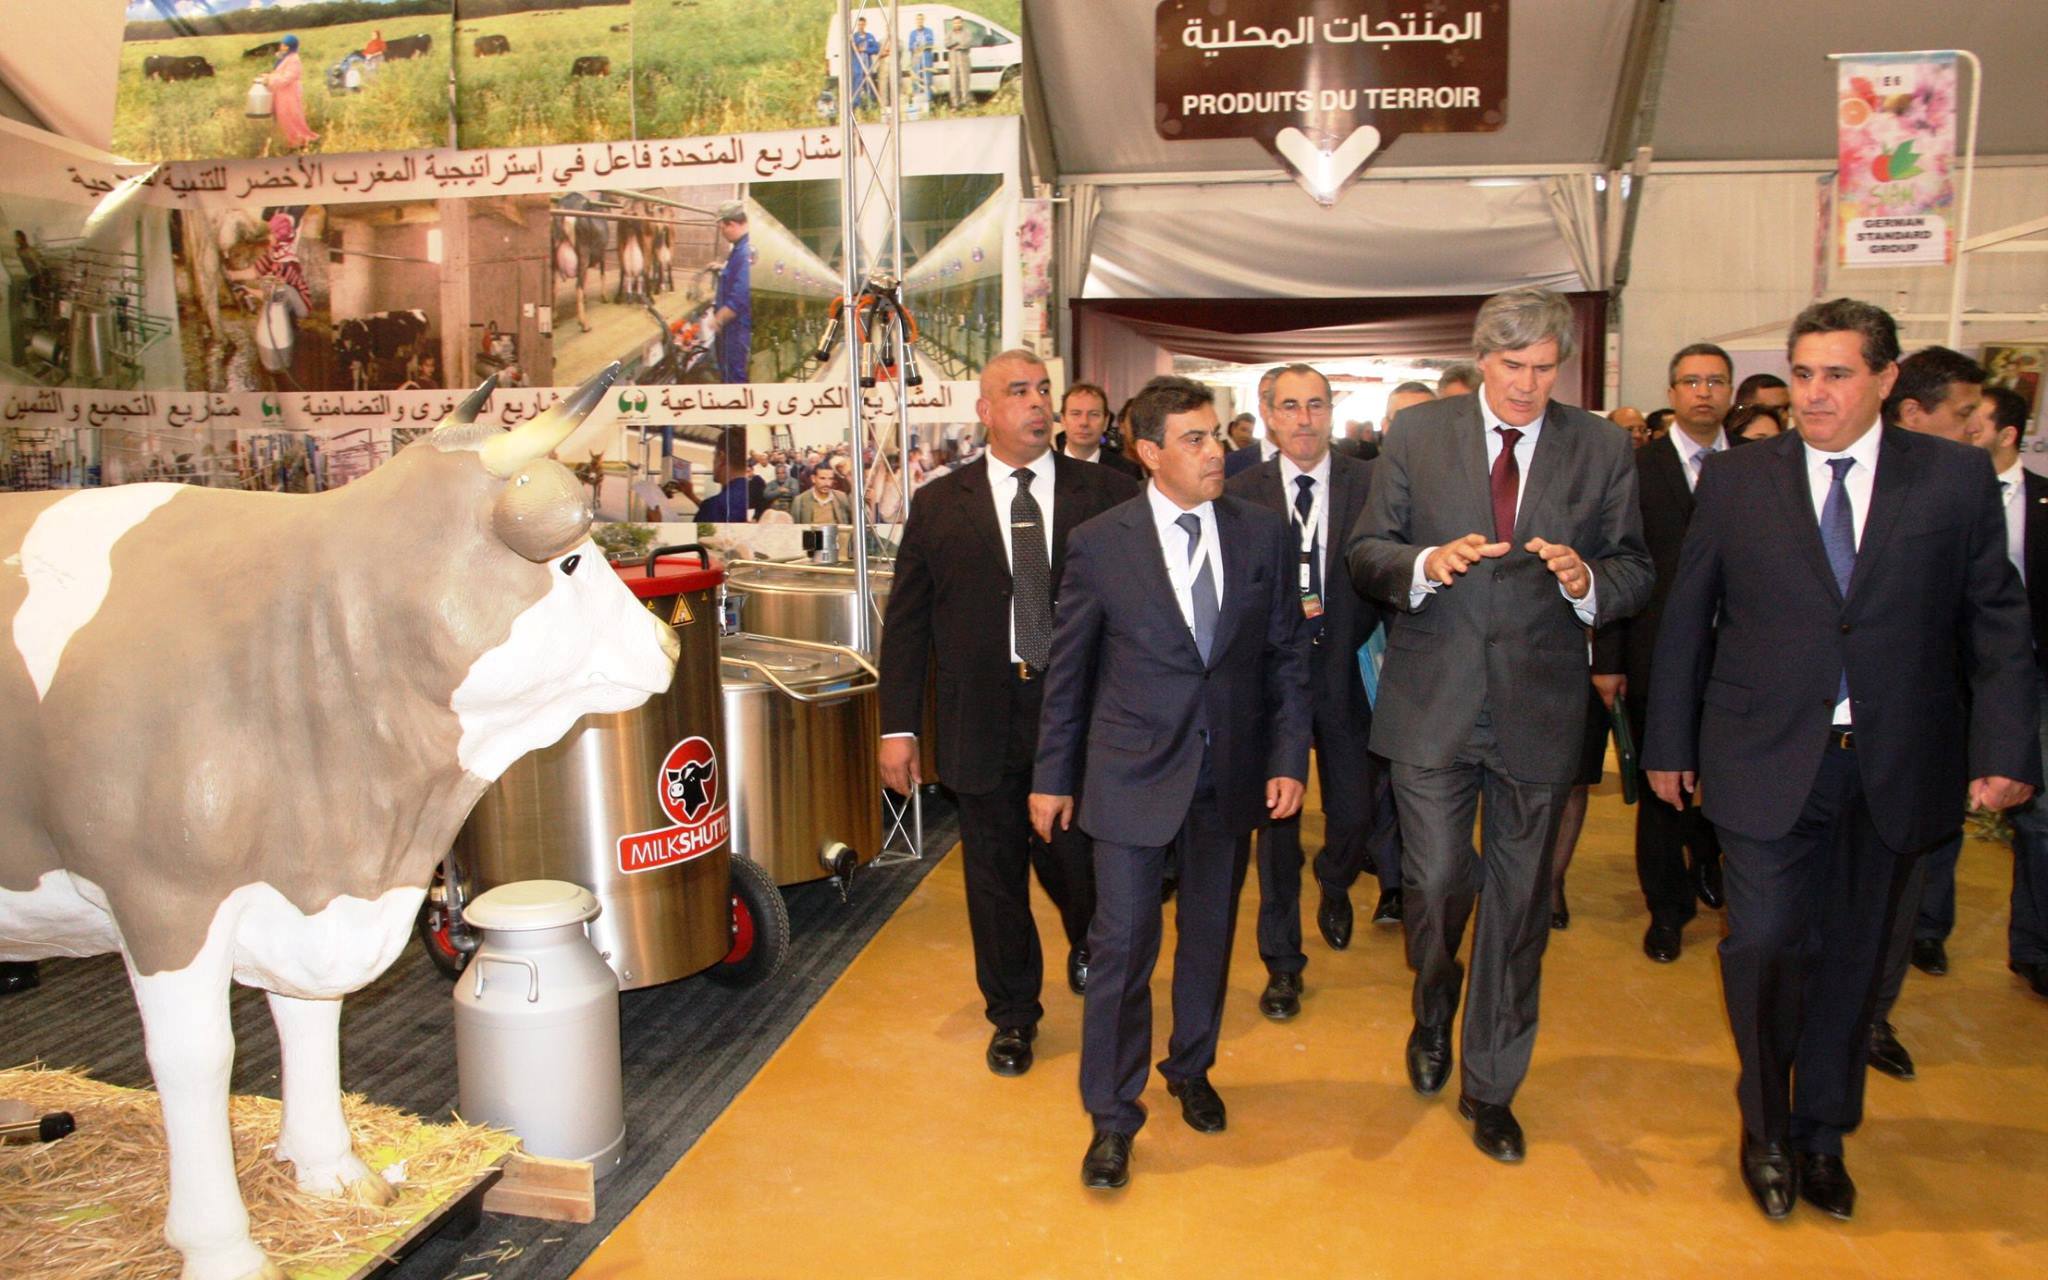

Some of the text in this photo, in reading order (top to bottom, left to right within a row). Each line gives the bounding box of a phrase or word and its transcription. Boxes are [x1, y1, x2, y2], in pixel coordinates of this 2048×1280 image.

[1182, 12, 1482, 57] المنتجات المحلية
[1182, 86, 1481, 115] PRODUITS DU TERROIR
[552, 146, 585, 187] في
[594, 144, 652, 177] فاعل
[660, 136, 744, 168] المتحدة
[236, 159, 324, 198] الأخضر
[332, 156, 416, 193] المغرب
[1856, 230, 1933, 241] STANDARD
[1863, 217, 1925, 229] GERMAN
[1869, 243, 1920, 254] GROUP
[87, 394, 157, 427] التجميع
[167, 395, 241, 427] مشاريع
[777, 386, 850, 417] الكبرى
